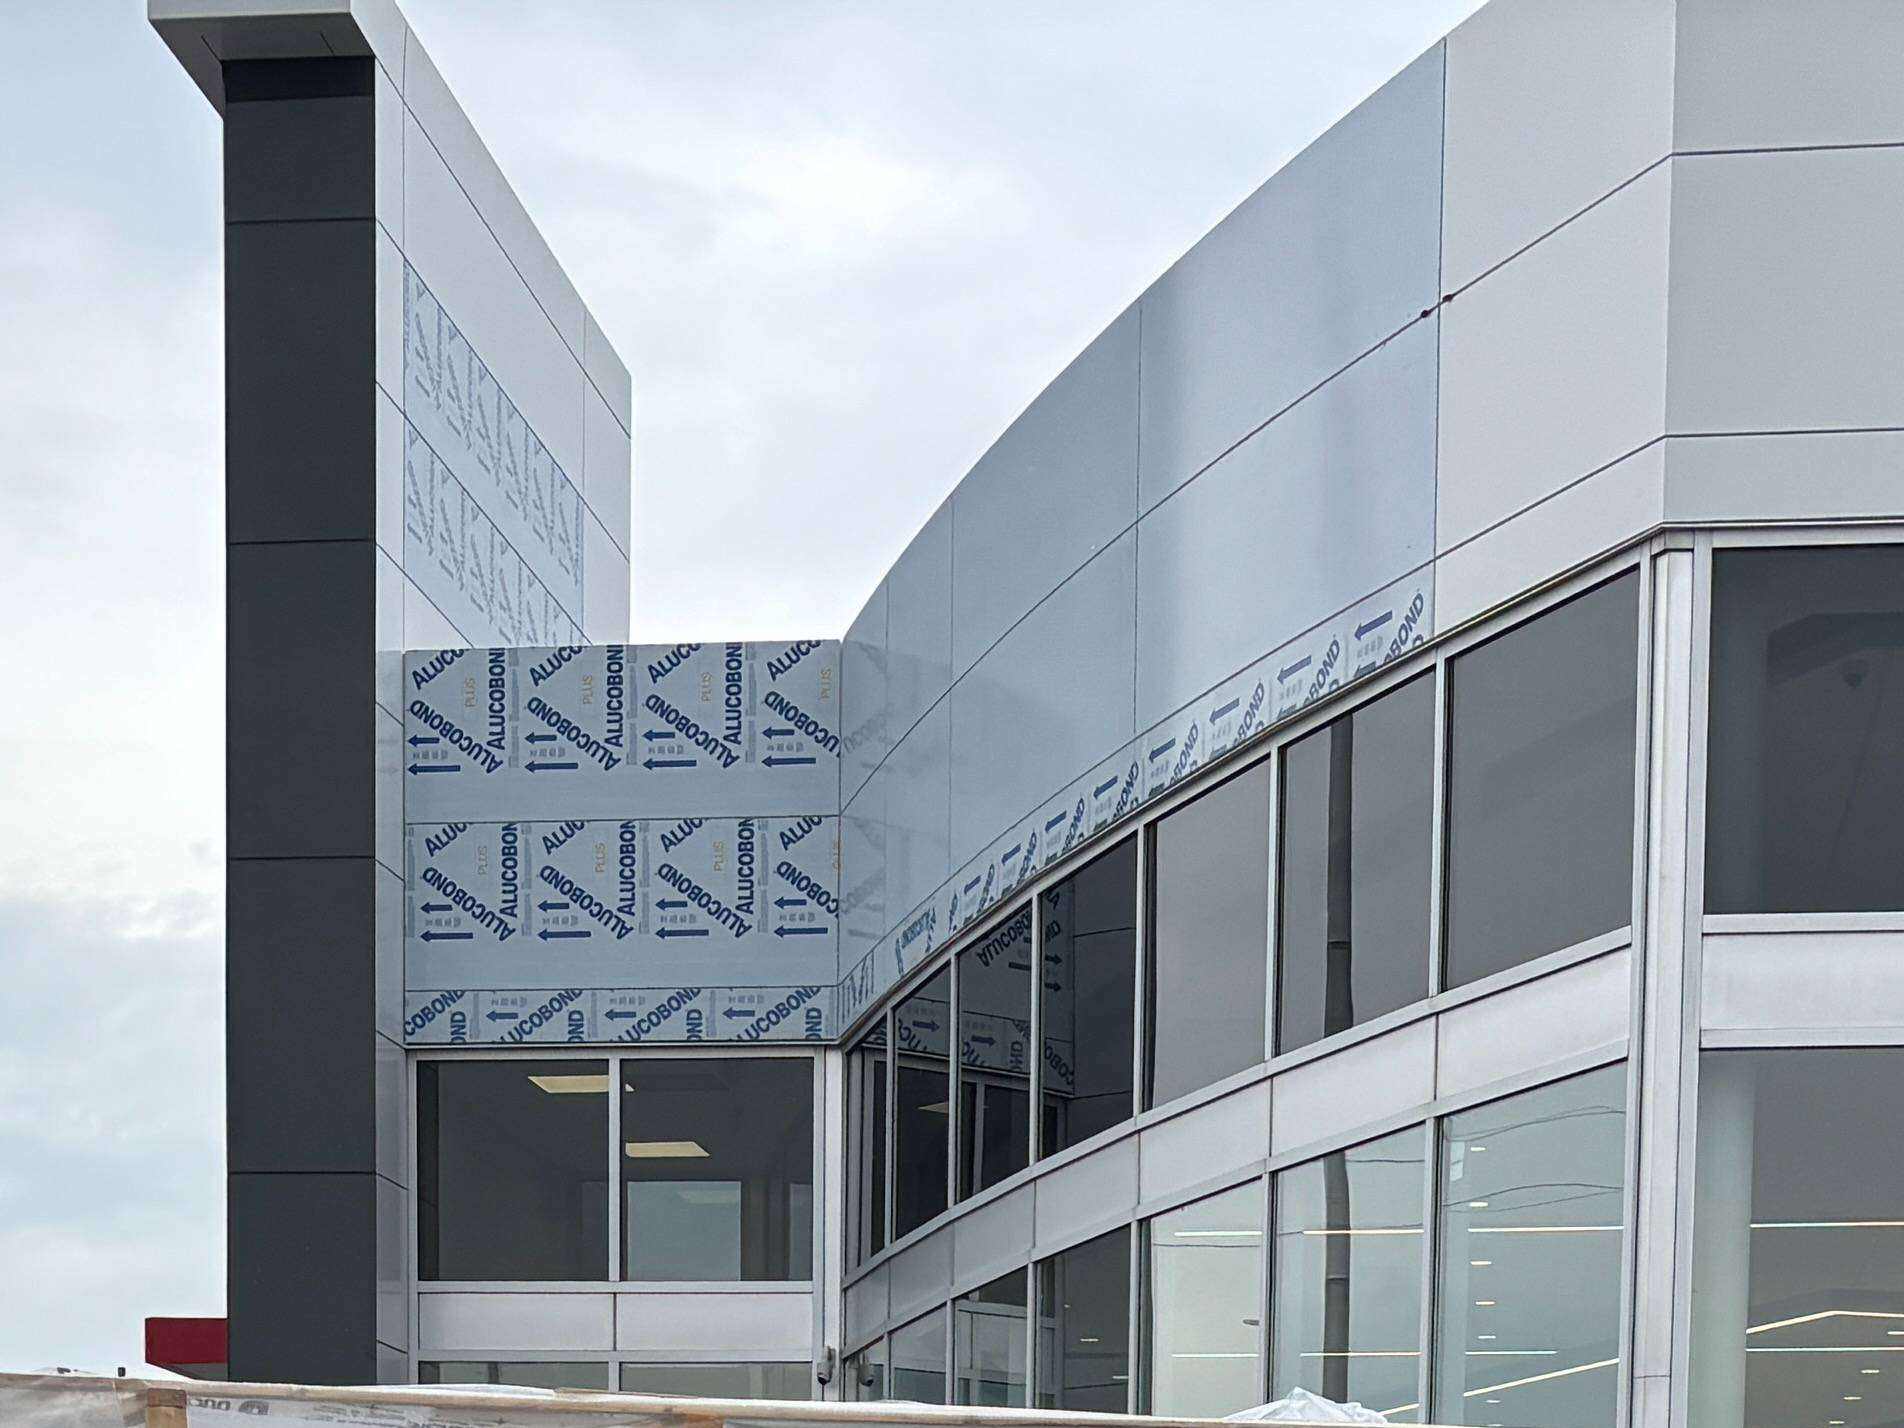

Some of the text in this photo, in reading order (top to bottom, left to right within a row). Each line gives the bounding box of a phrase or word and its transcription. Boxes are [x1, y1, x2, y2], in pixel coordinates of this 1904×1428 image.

[487, 647, 506, 750] ALUCOBON
[604, 645, 624, 748] ALUCOBON
[723, 642, 743, 745] ALUCOBON
[764, 691, 840, 758] UCOBOND
[410, 700, 504, 774] ALUCOBOND
[527, 697, 622, 771] ALUCOBOND
[646, 694, 740, 769] ALUCOBOND
[423, 867, 516, 941] ALUCOBOND
[539, 865, 634, 940] ALUCOBOND
[658, 863, 752, 938] ALUCOBOND
[776, 861, 839, 919] COBOND
